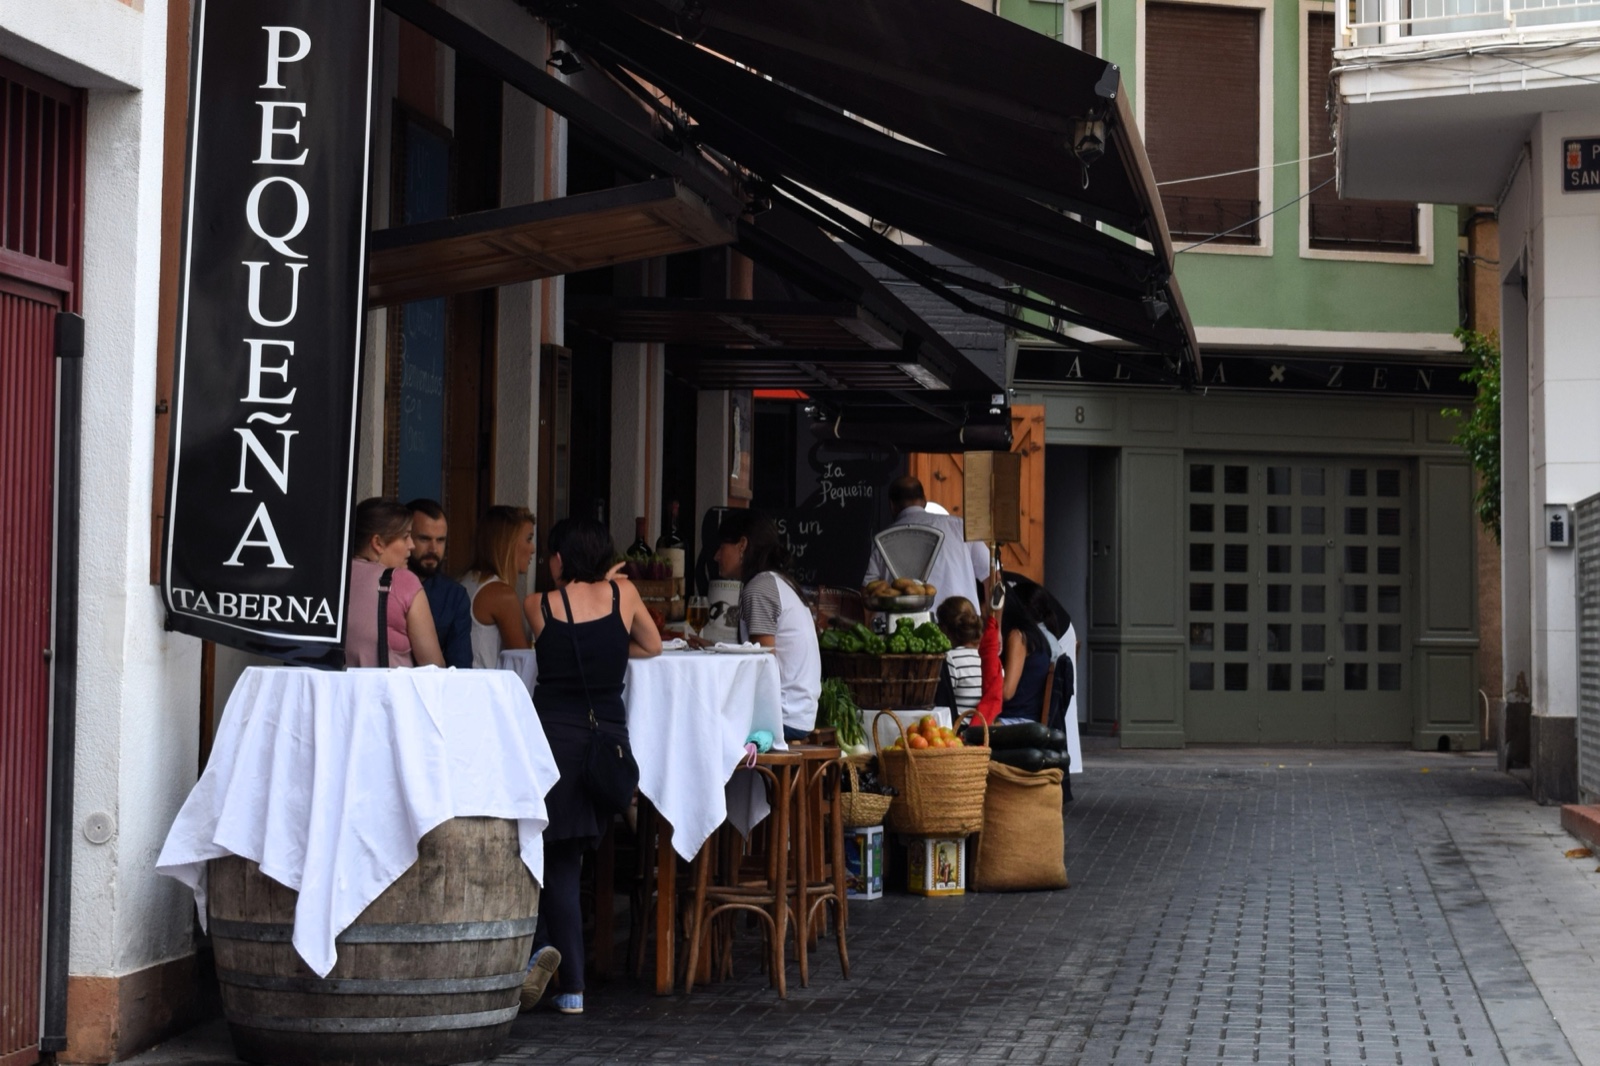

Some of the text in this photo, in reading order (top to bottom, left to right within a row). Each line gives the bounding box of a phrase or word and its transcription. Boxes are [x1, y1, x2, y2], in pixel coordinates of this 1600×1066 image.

[1571, 171, 1600, 185] SAN
[222, 26, 312, 569] PEQUEÑA
[1065, 355, 1435, 391] ALA ZEN
[1075, 405, 1085, 424] 8
[823, 462, 845, 478] La
[798, 520, 824, 536] un
[172, 587, 337, 625] TABERNA
